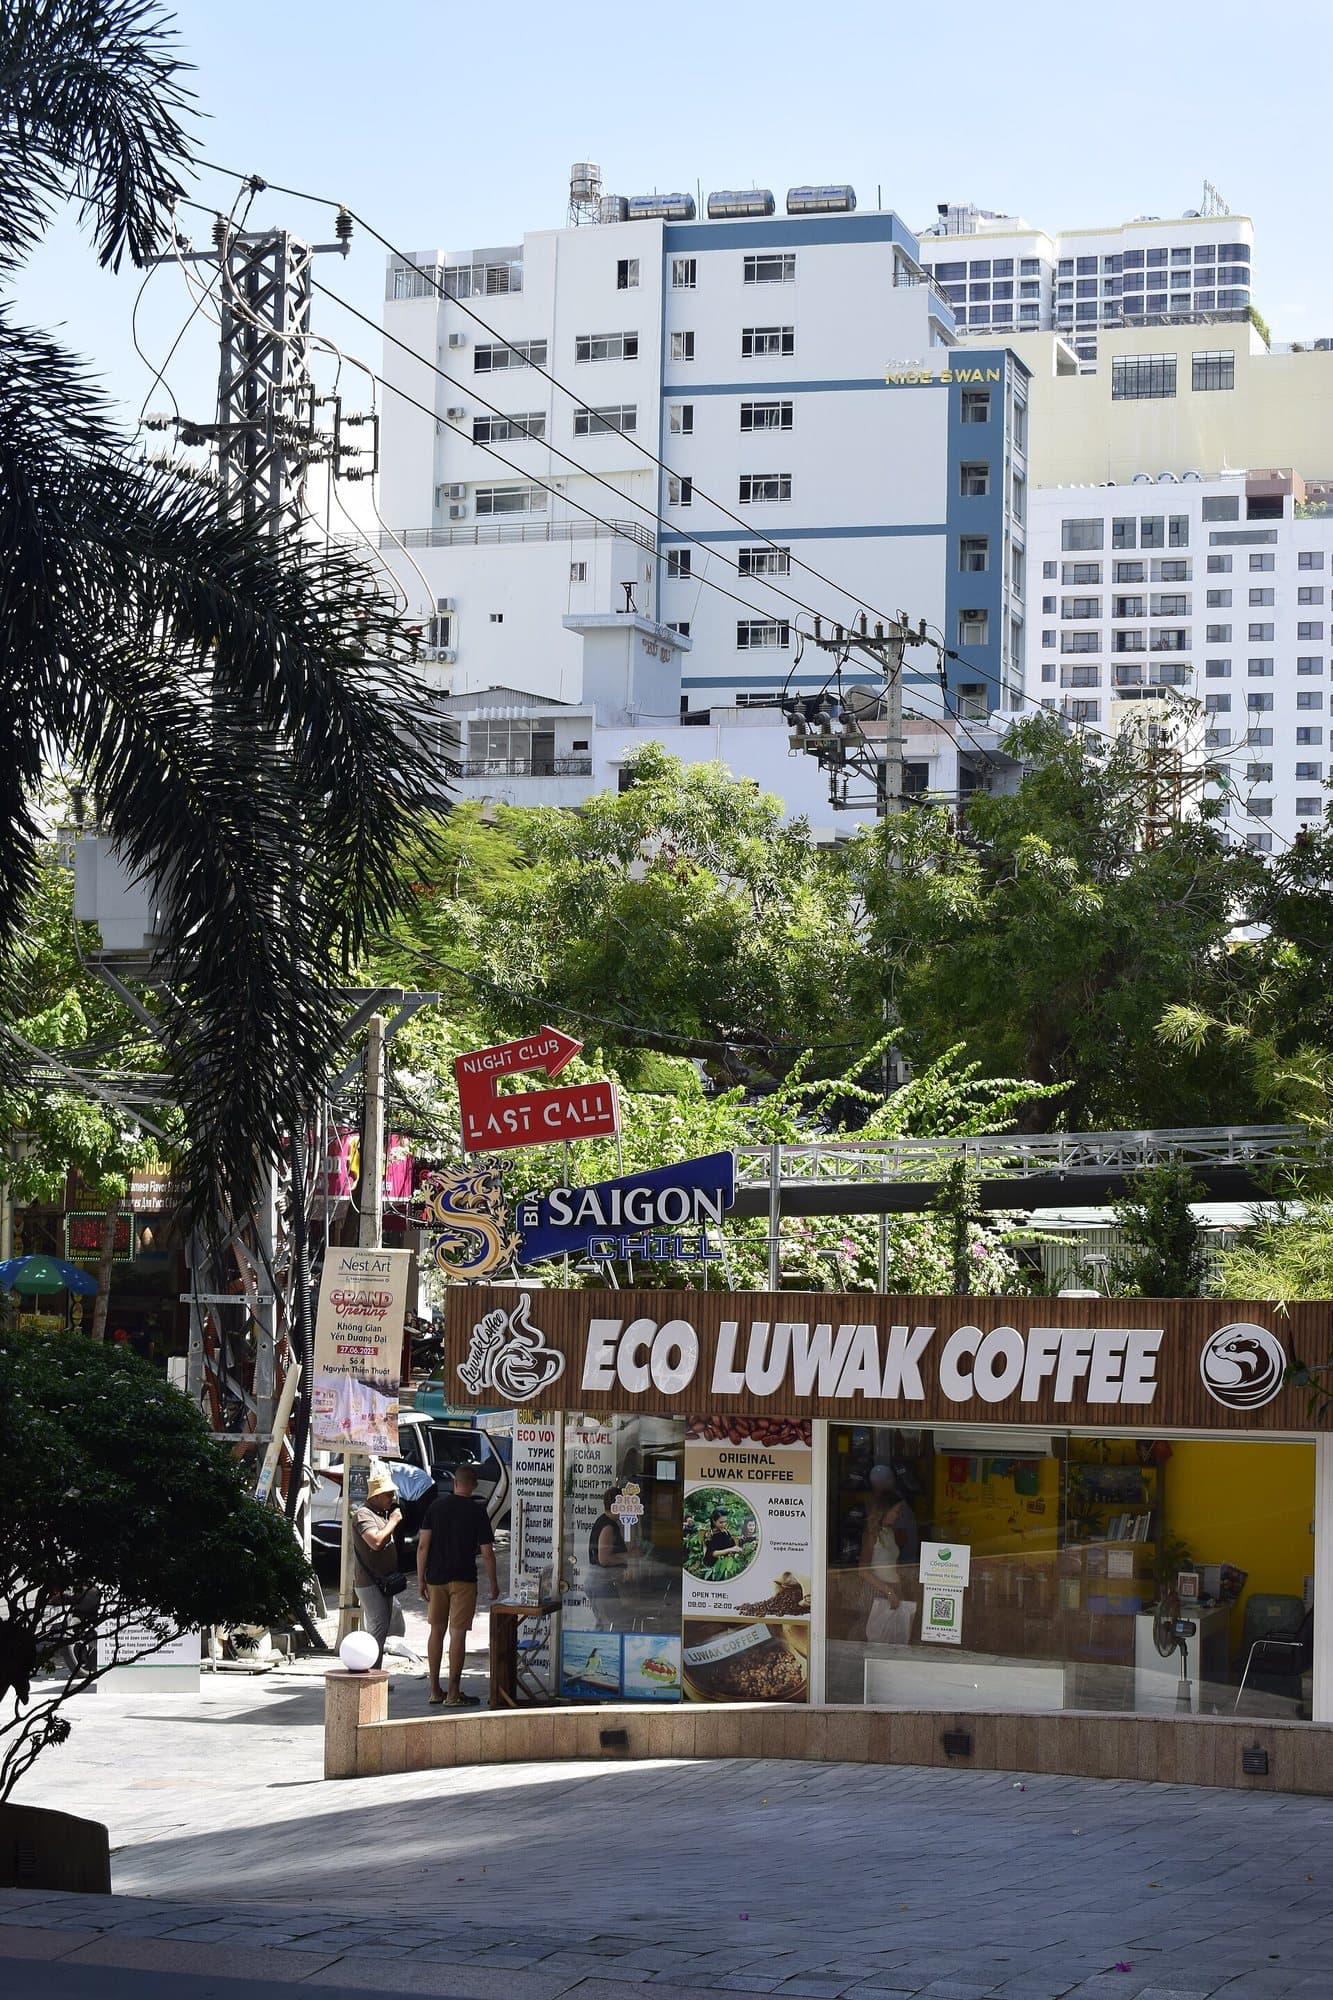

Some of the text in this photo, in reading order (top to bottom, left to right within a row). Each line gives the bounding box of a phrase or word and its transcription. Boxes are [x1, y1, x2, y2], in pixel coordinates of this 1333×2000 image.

[885, 368, 1000, 385] NICE SWAN
[463, 1039, 560, 1074] NIGHT CLUB
[469, 1096, 610, 1138] LAST CALL
[524, 1187, 723, 1227] BIA SAIGON
[587, 1234, 724, 1260] CHILL
[341, 1255, 391, 1272] Nest Art
[330, 1289, 393, 1308] GRAND
[335, 1304, 387, 1321] Opening
[365, 1324, 382, 1332] Gian
[581, 1318, 1164, 1404] ECO LUWAK COFFEE
[517, 1430, 536, 1442] ECO
[719, 1452, 775, 1465] ORIGINAL
[587, 1464, 613, 1475] ВОЯЖ
[700, 1467, 794, 1481] LUWAK COFFEE
[579, 1479, 600, 1489] ЦЕНТР
[768, 1498, 804, 1506] ARABICA
[768, 1509, 806, 1517] ROBUSTA
[525, 1517, 542, 1529] Далат
[691, 1591, 709, 1599] OPEN
[688, 1631, 760, 1662] LUWAK COFFEE
